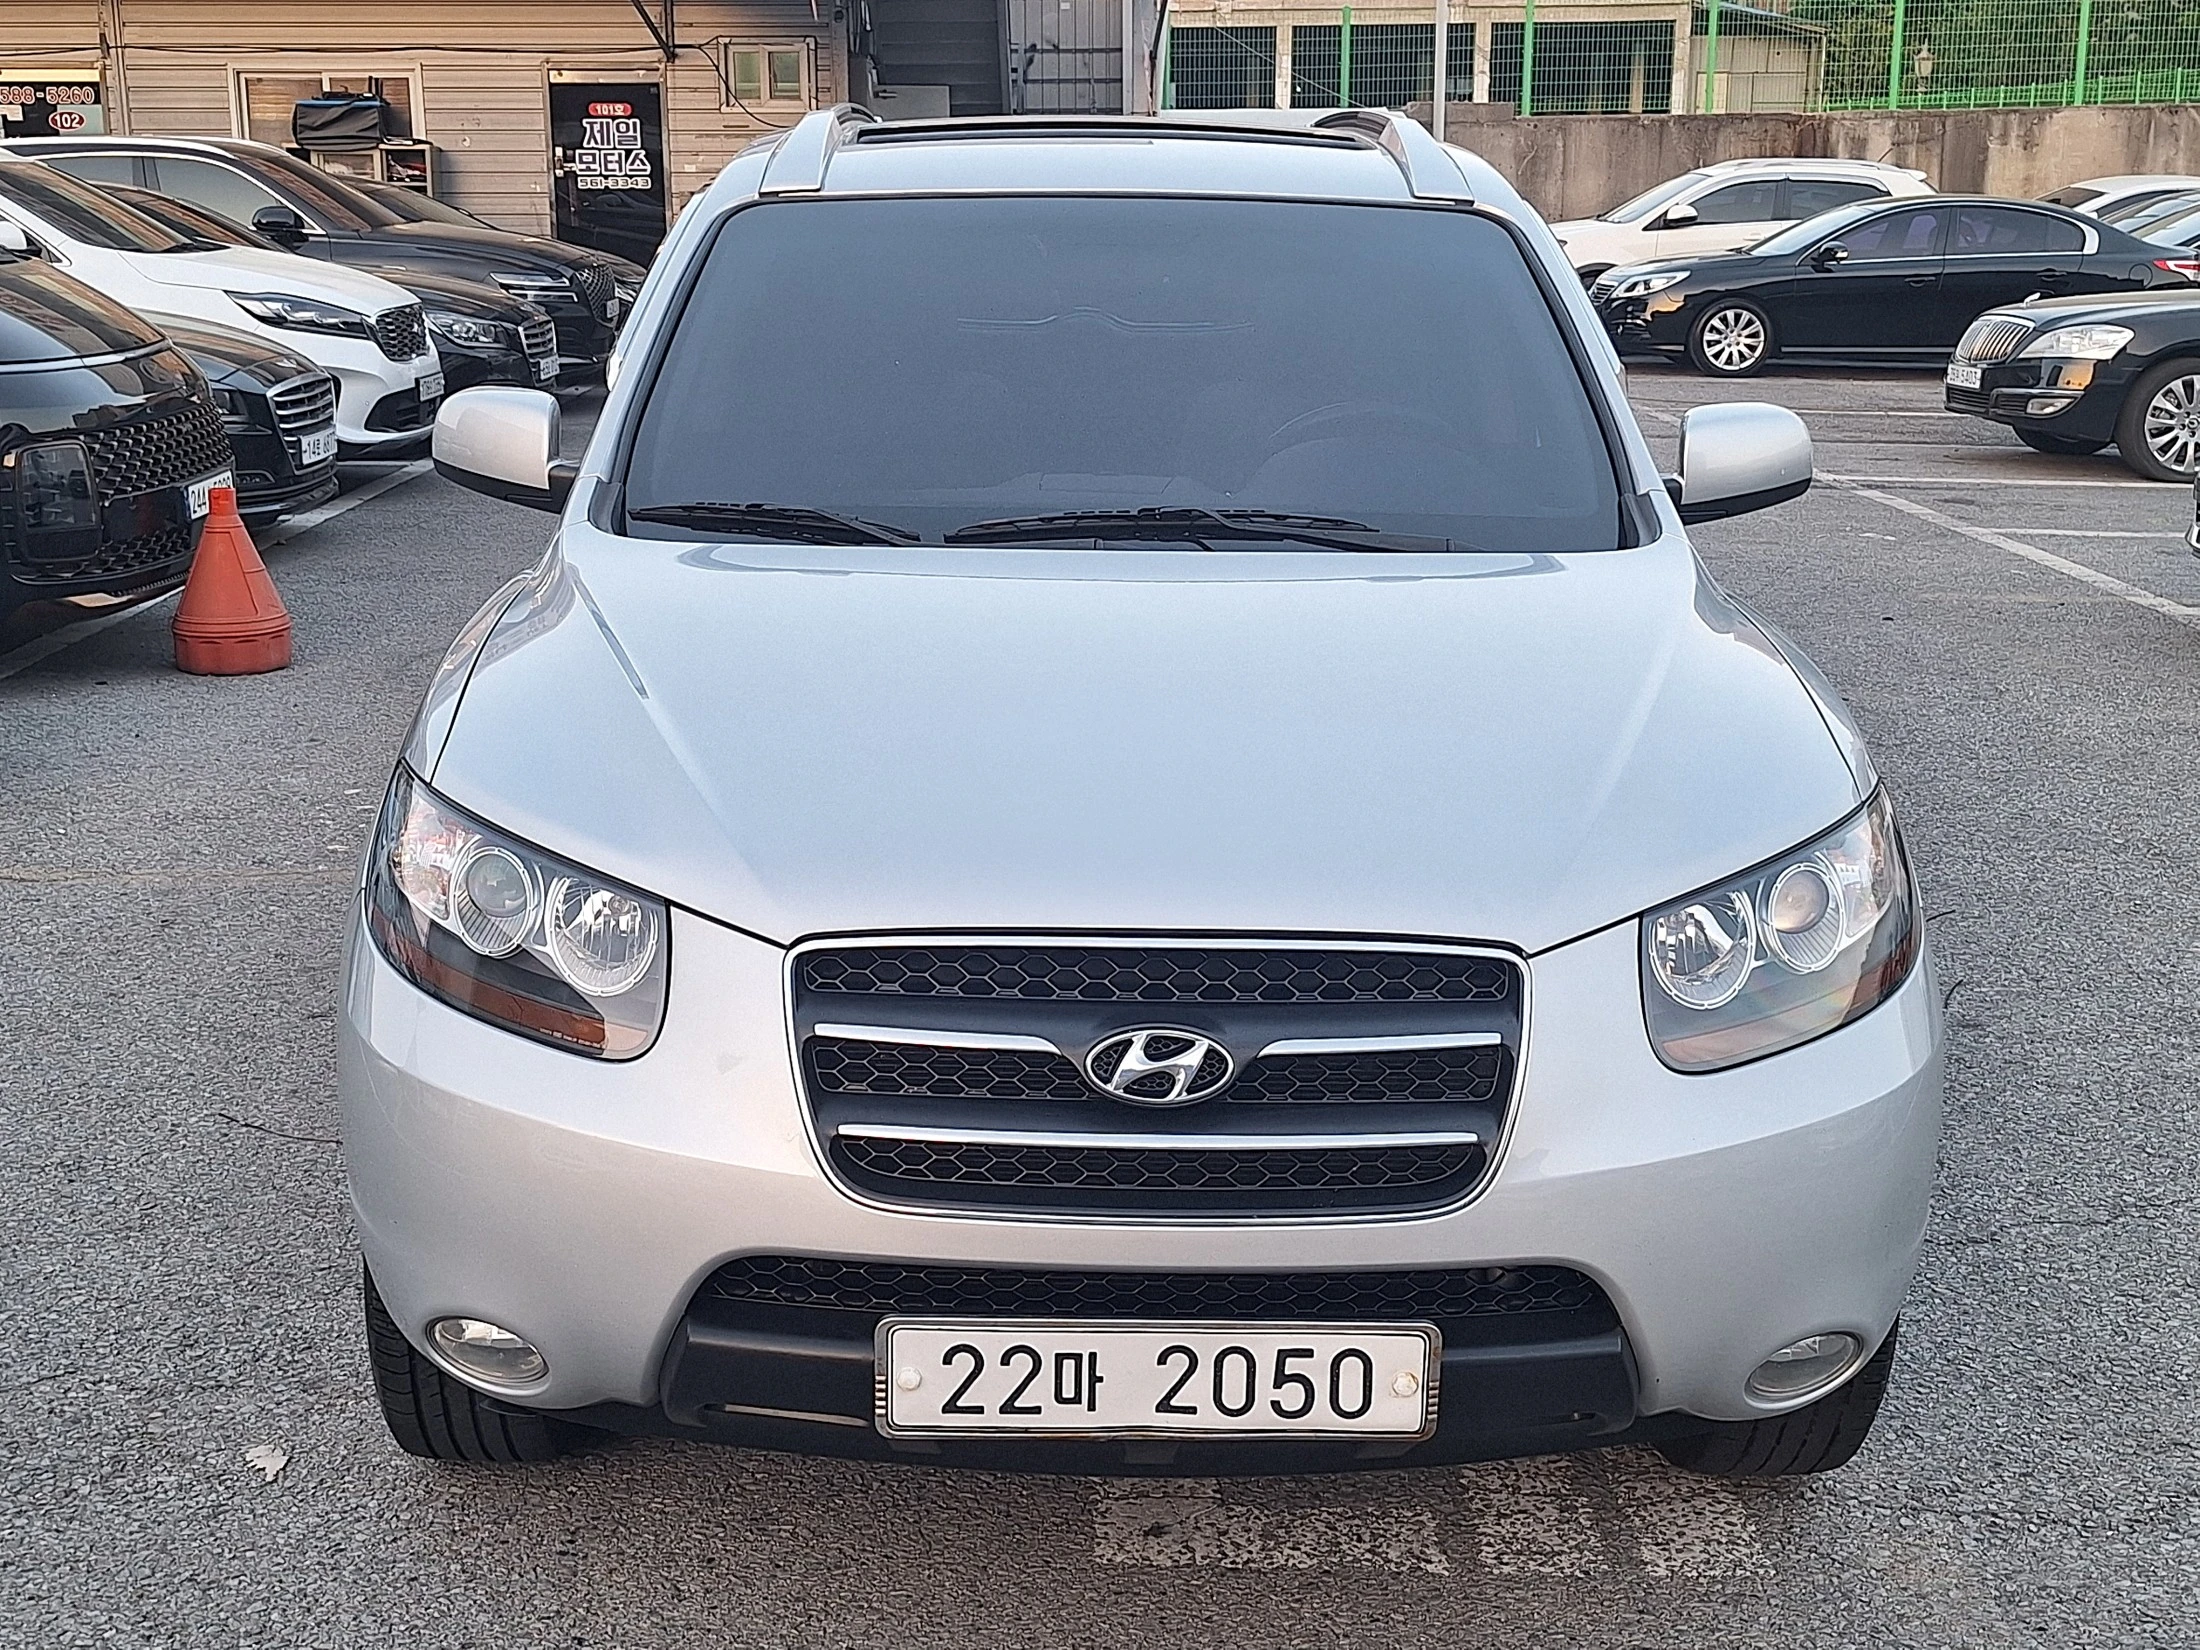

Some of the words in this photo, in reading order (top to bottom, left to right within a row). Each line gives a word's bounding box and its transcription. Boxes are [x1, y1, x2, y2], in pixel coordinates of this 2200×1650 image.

[54, 113, 81, 128] 102
[582, 118, 641, 149] 제일
[575, 150, 651, 175] 모터스
[577, 177, 651, 189] 561-3343
[941, 1344, 1104, 1415] 22마
[1154, 1344, 1374, 1420] 2050
